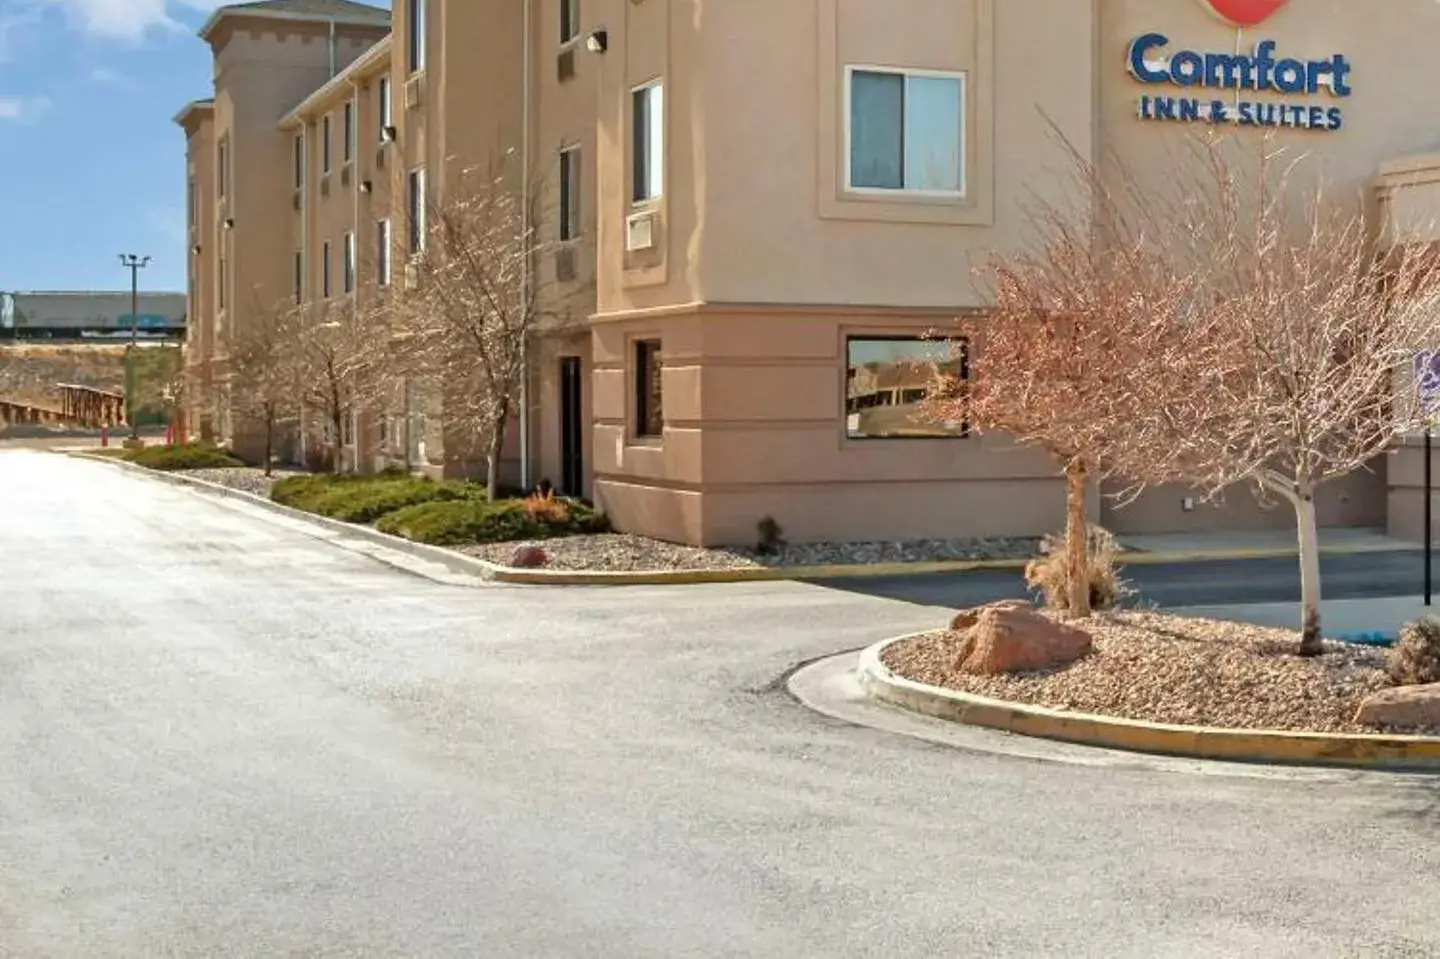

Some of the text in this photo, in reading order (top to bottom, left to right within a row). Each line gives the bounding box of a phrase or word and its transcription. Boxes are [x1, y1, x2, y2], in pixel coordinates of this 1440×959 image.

[1130, 33, 1351, 96] Comfort
[1141, 95, 1342, 130] INN & SUITES
